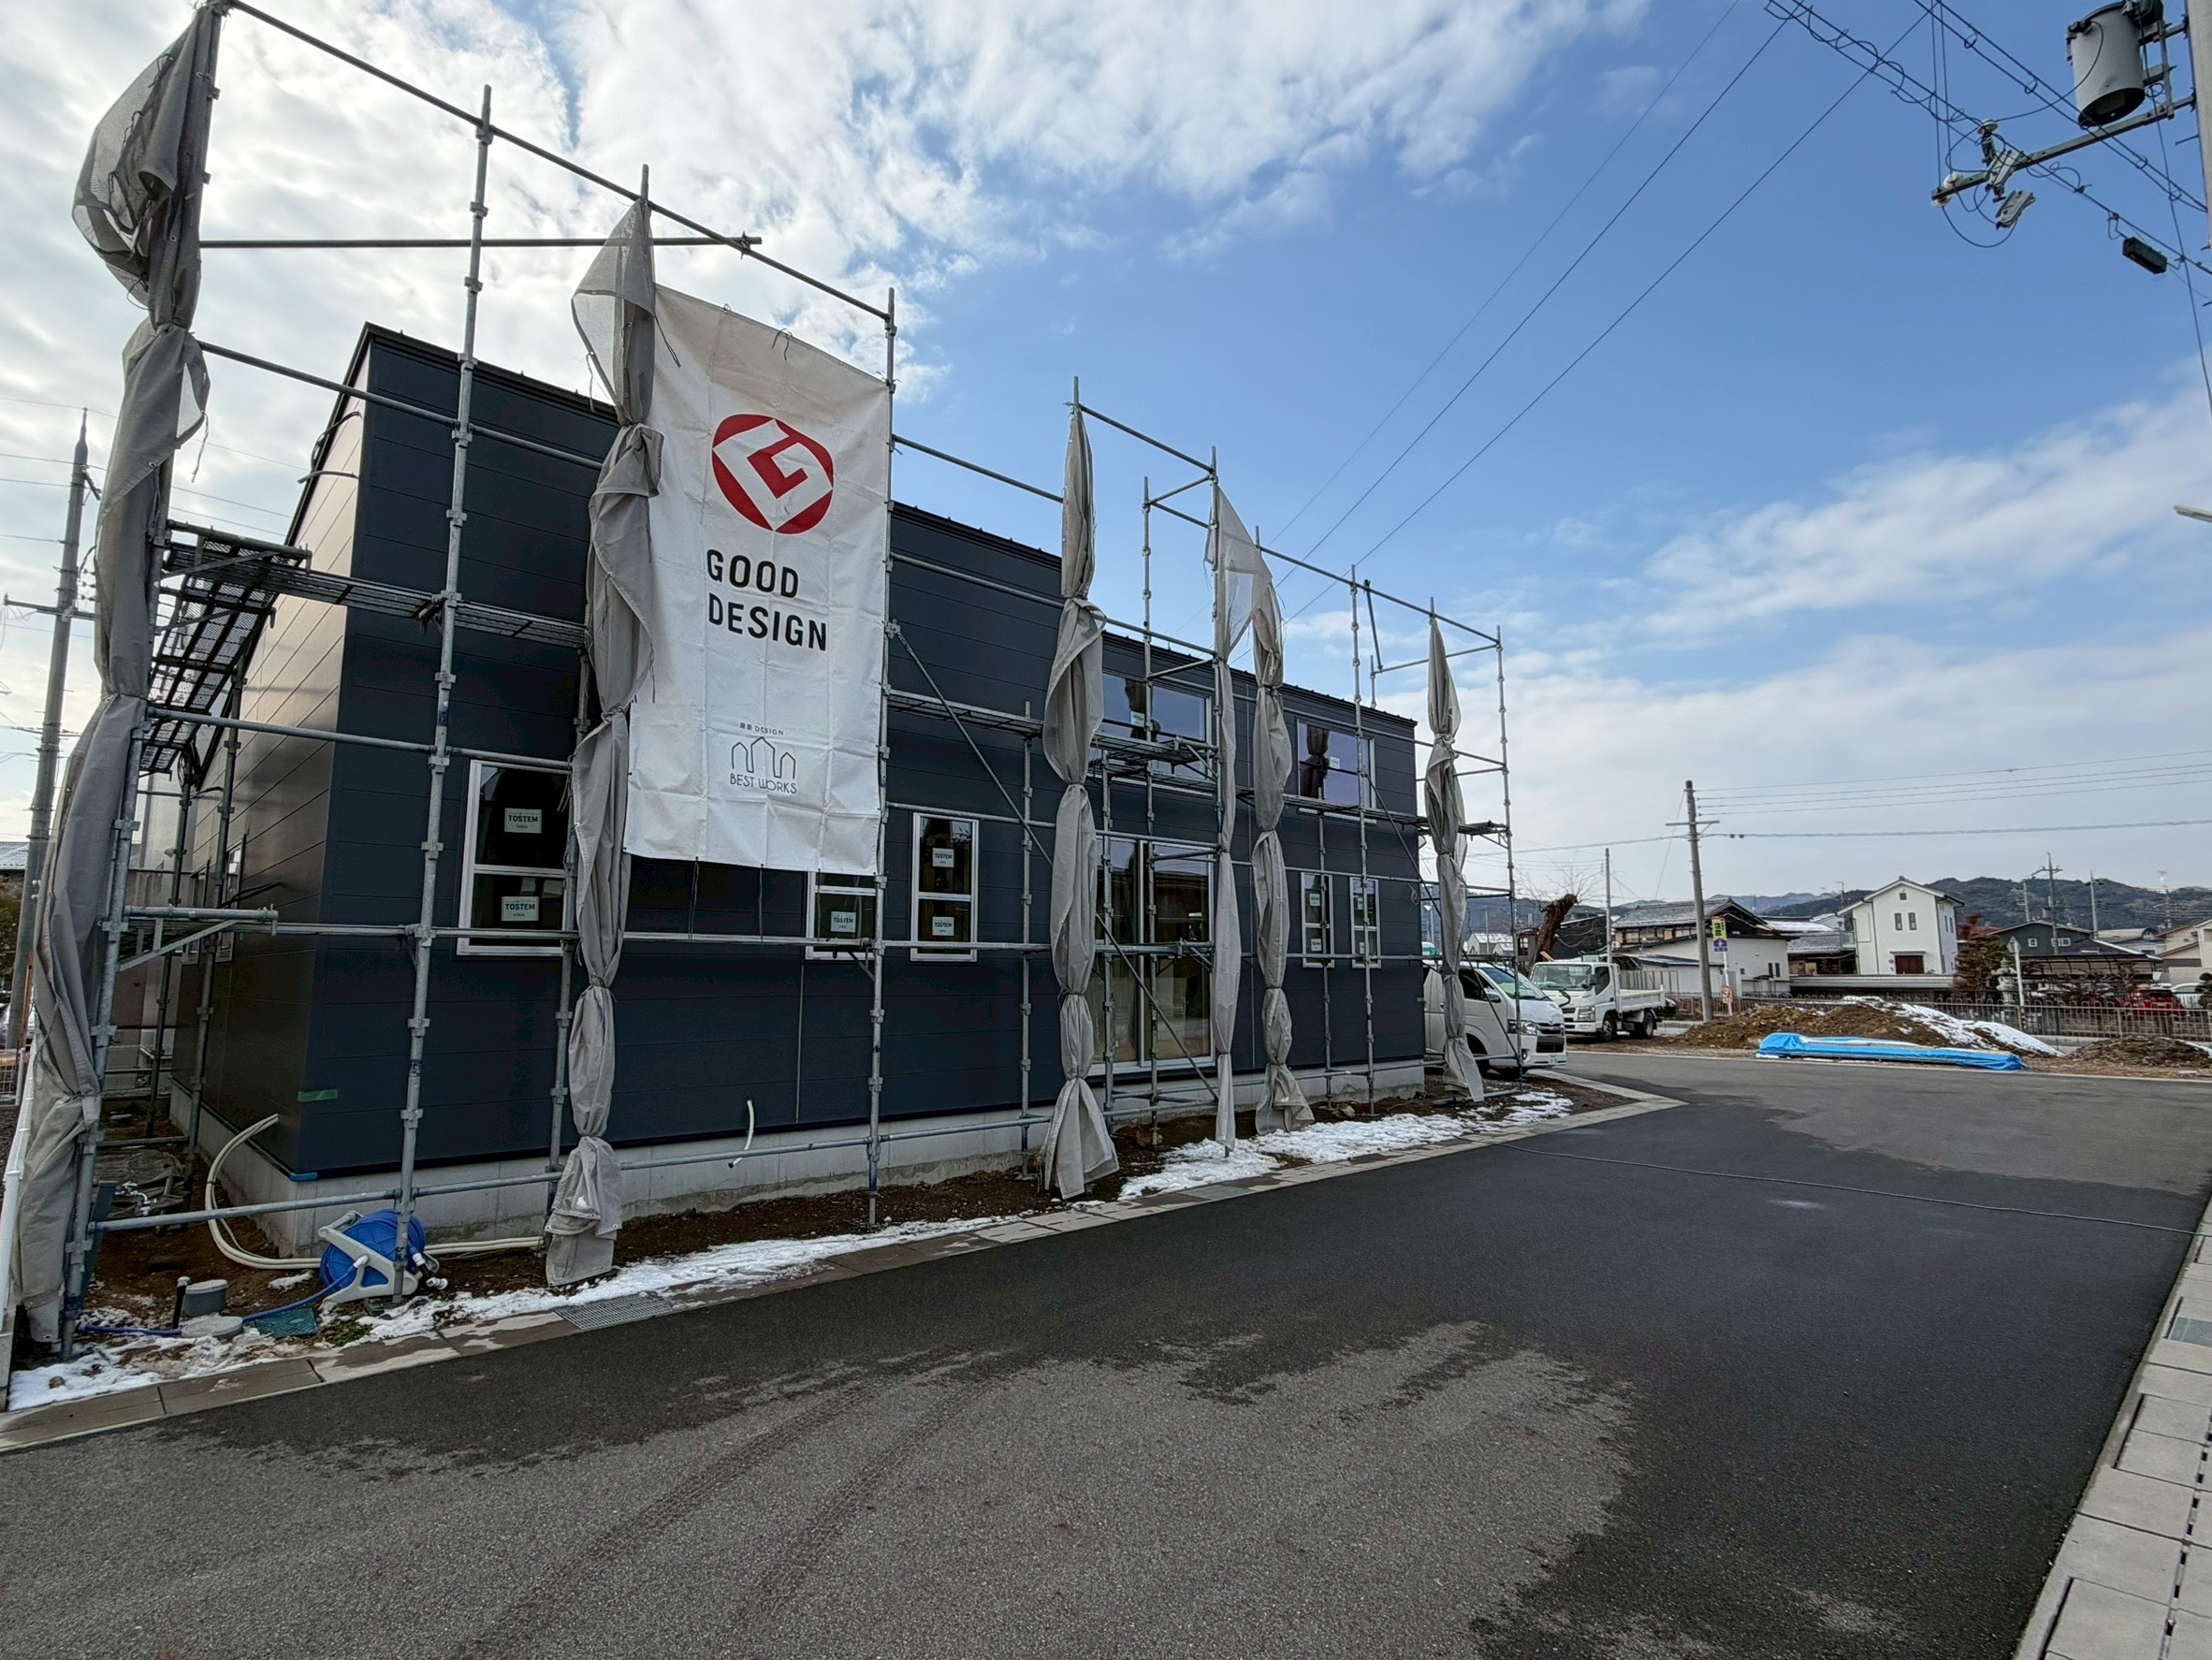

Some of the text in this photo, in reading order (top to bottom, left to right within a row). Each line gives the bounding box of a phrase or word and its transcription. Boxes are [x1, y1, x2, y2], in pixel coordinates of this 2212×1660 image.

[706, 548, 799, 599] GOOD
[708, 592, 827, 652] DESIGN
[754, 725, 784, 735] DESIGN
[730, 773, 797, 794] BEST WORKS
[507, 814, 539, 823] TOSTEM
